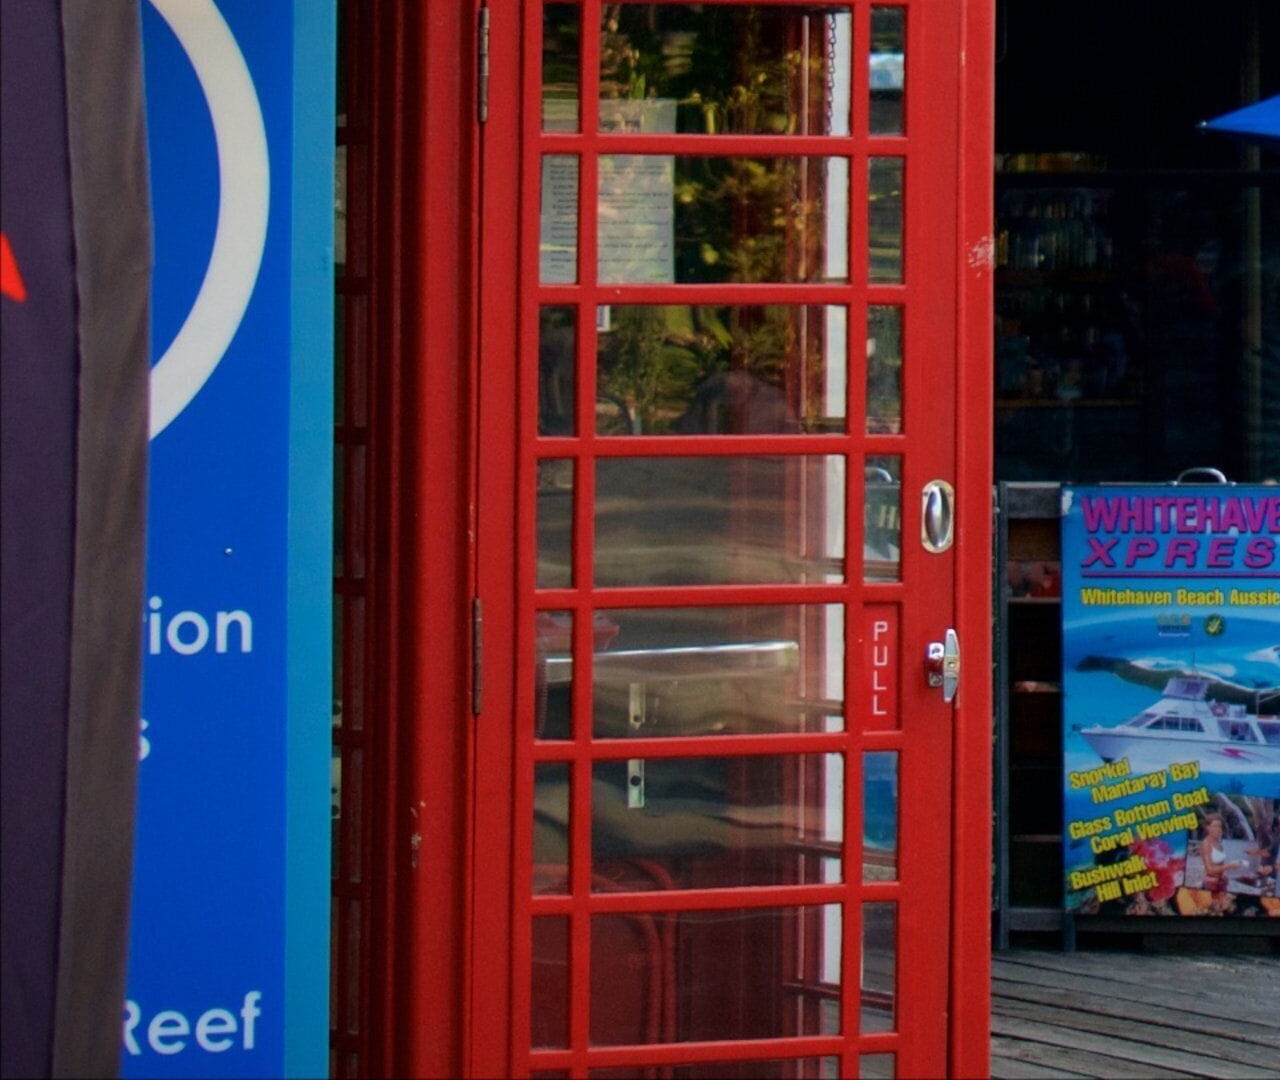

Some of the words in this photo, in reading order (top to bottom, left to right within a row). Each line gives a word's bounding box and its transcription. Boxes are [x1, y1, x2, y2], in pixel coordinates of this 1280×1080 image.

[1081, 588, 1172, 606] Whitehaven
[1176, 588, 1224, 606] Beach
[1229, 588, 1280, 606] Aussie
[147, 596, 253, 655] ion
[873, 621, 889, 715] PULL
[1069, 757, 1131, 790] Snorkel
[1091, 769, 1167, 804] Mantaray
[1169, 760, 1200, 782] Bay
[1069, 815, 1112, 841] Glass
[1113, 798, 1171, 827] Bottom
[1172, 787, 1211, 812] Boat
[1090, 829, 1134, 855] Coral
[1137, 812, 1199, 841] Viewing
[1069, 856, 1147, 891] Bushwalk
[1096, 880, 1122, 903] Hill
[1123, 871, 1159, 896] Inlet
